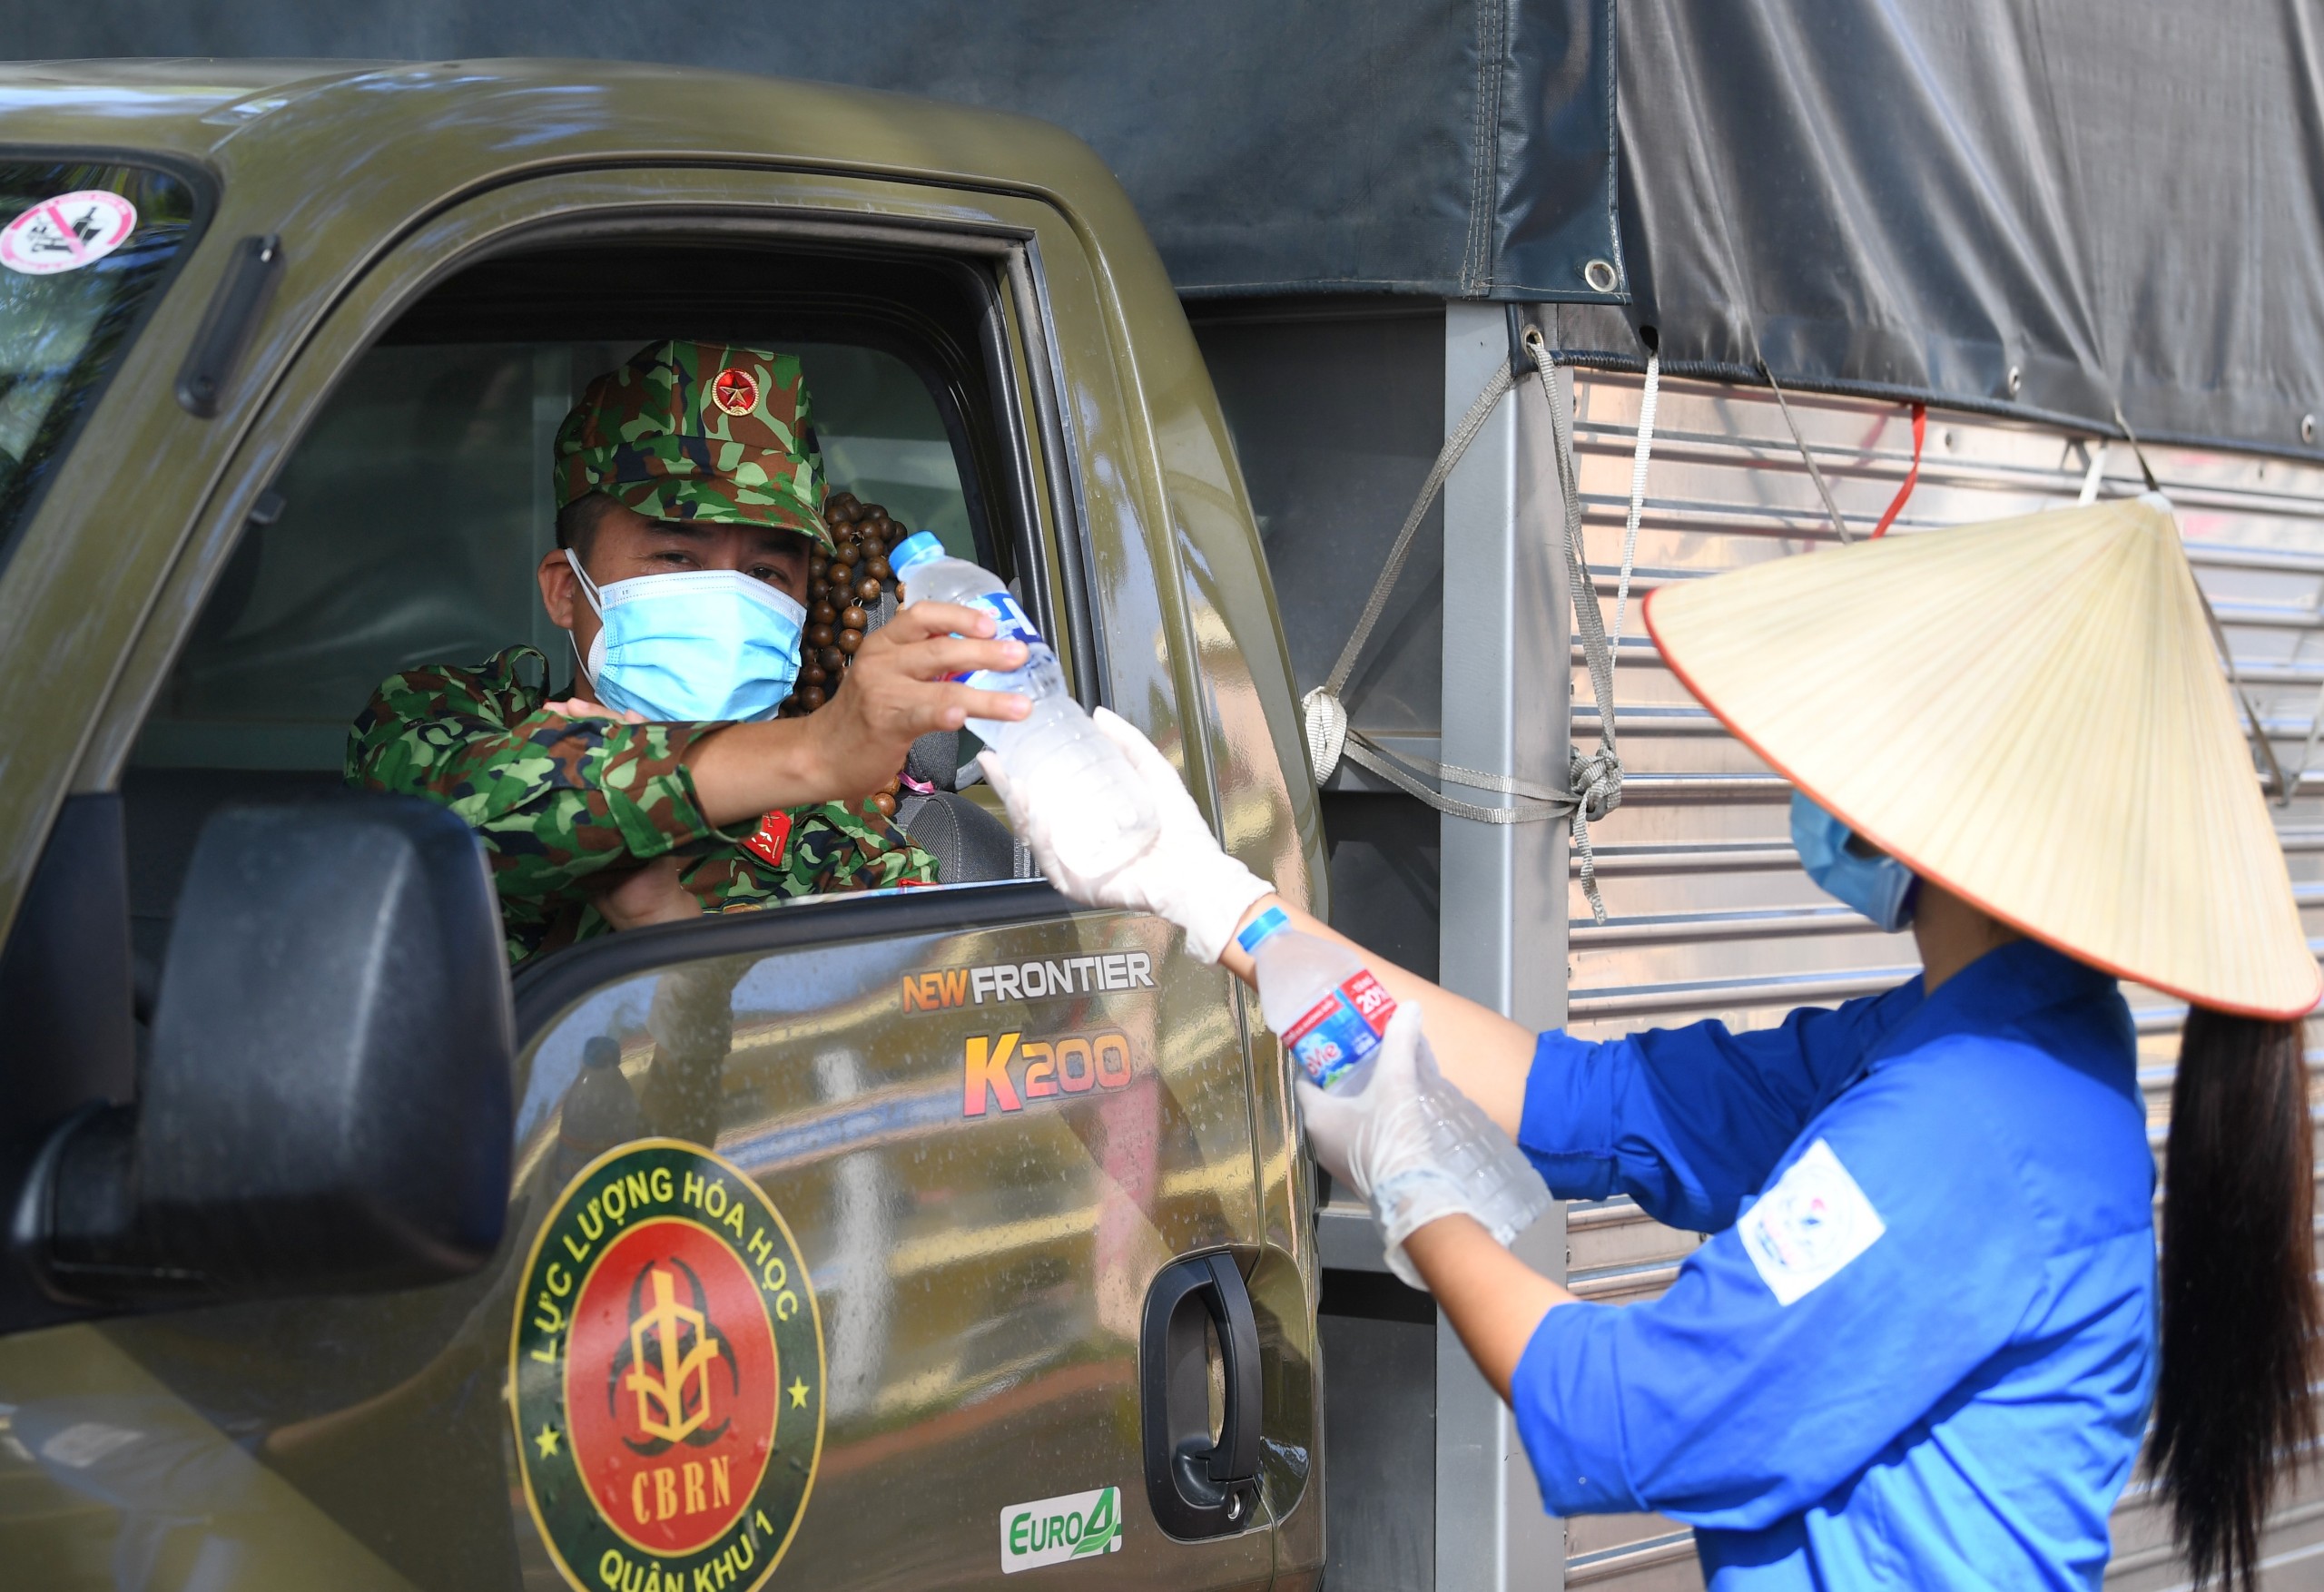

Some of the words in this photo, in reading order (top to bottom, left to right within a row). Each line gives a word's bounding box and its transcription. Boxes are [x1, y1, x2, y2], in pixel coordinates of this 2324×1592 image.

[902, 968, 969, 1014] NEW
[970, 951, 1155, 1005] FRONTIER
[963, 1031, 1132, 1117] K200
[530, 1262, 572, 1364] LỰC
[562, 1166, 675, 1263] LƯỢNG
[683, 1171, 744, 1239] HÓA
[746, 1226, 798, 1322] HỌC
[631, 1455, 732, 1526] CBRN
[598, 1548, 685, 1592] QUÂN
[693, 1533, 754, 1592] KHU
[755, 1508, 773, 1536] 1
